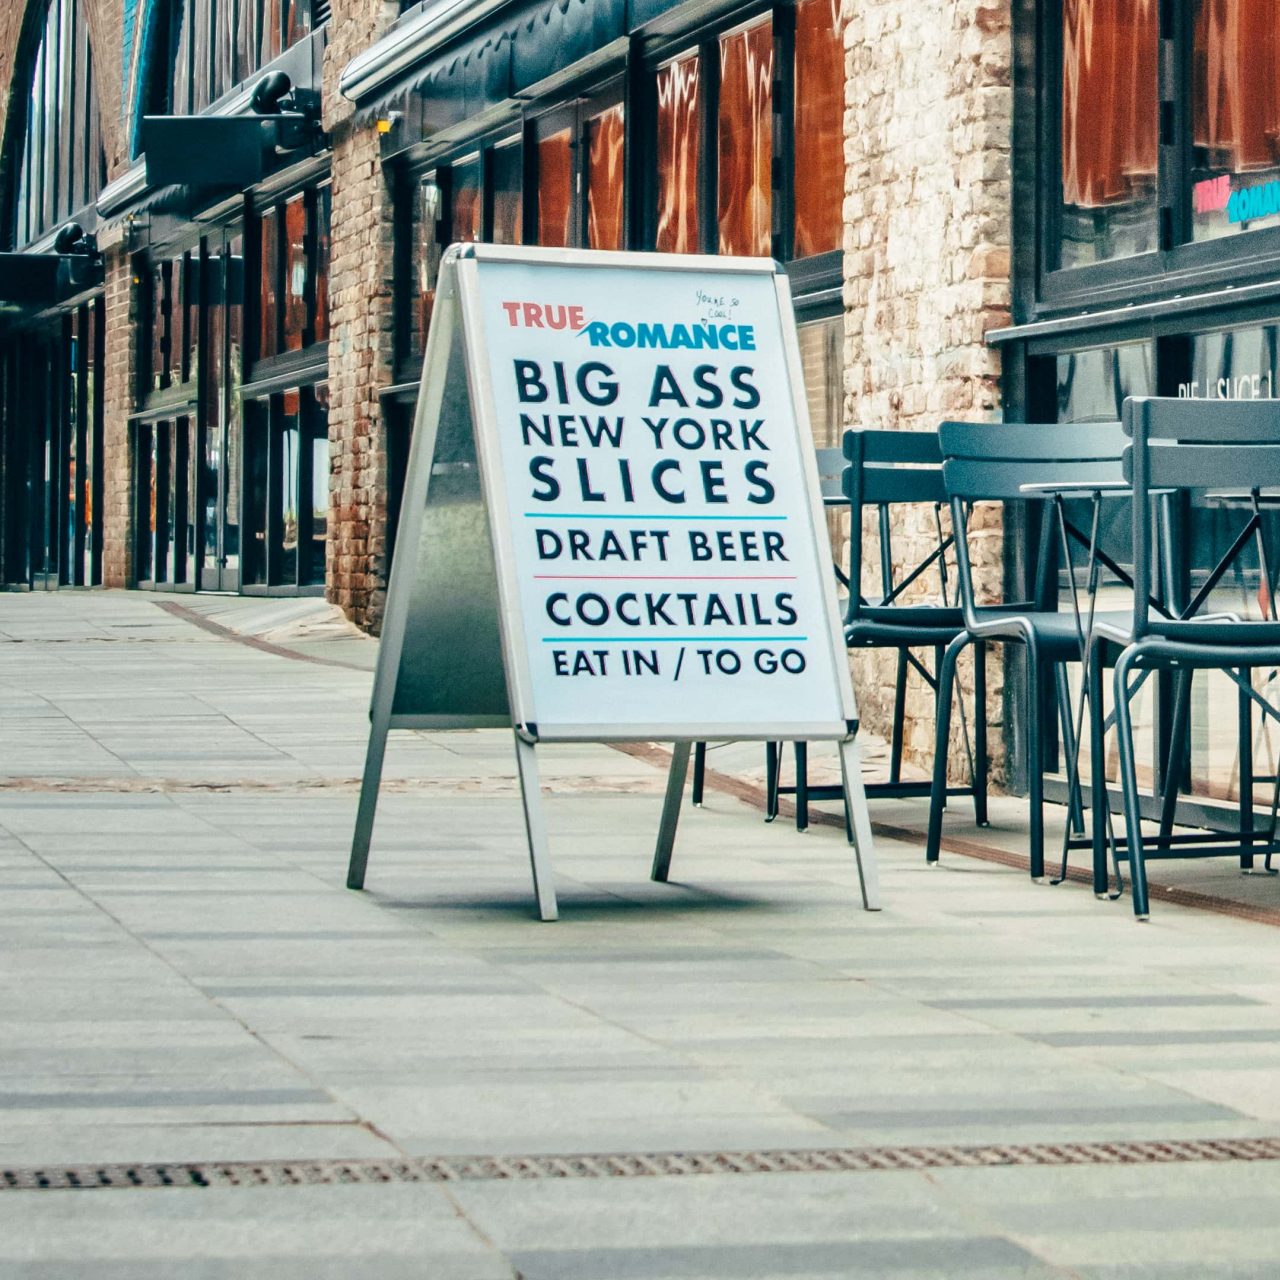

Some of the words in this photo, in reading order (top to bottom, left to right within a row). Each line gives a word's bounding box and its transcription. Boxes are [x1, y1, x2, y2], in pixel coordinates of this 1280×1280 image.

[1194, 175, 1230, 214] TRUE
[502, 302, 584, 331] TRUE
[578, 322, 757, 351] ROMANCE
[513, 359, 619, 407] BIG
[649, 365, 761, 409] ASS
[519, 414, 625, 448] NEW
[641, 417, 770, 451] YORK
[528, 456, 776, 505] SLICES
[535, 529, 670, 562] DRAFT
[688, 531, 790, 562] BEER
[545, 592, 798, 626] COCKTAILS
[553, 650, 609, 676] EAT
[622, 650, 659, 676] IN
[697, 649, 741, 675] TO
[754, 648, 807, 674] GO
